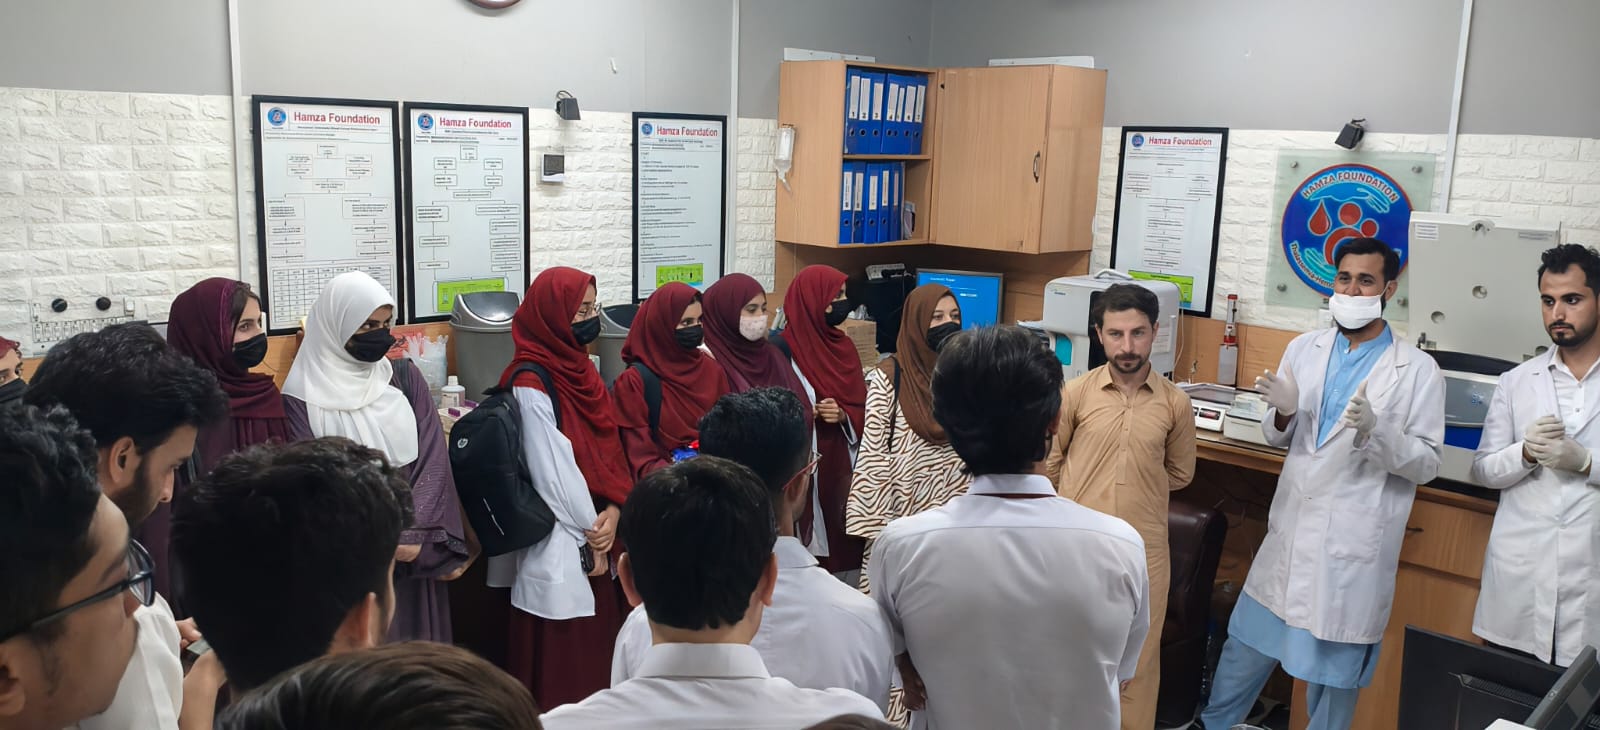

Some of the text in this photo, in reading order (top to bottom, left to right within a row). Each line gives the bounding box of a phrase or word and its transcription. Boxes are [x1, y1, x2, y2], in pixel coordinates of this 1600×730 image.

[294, 112, 380, 124] Hamza Foundation
[439, 117, 512, 128] Hamza Foundation
[656, 125, 718, 137] Hamza Foundation
[1149, 136, 1212, 146] Hamza Foundation
[1302, 171, 1398, 202] HAMZA FOUNDATION
